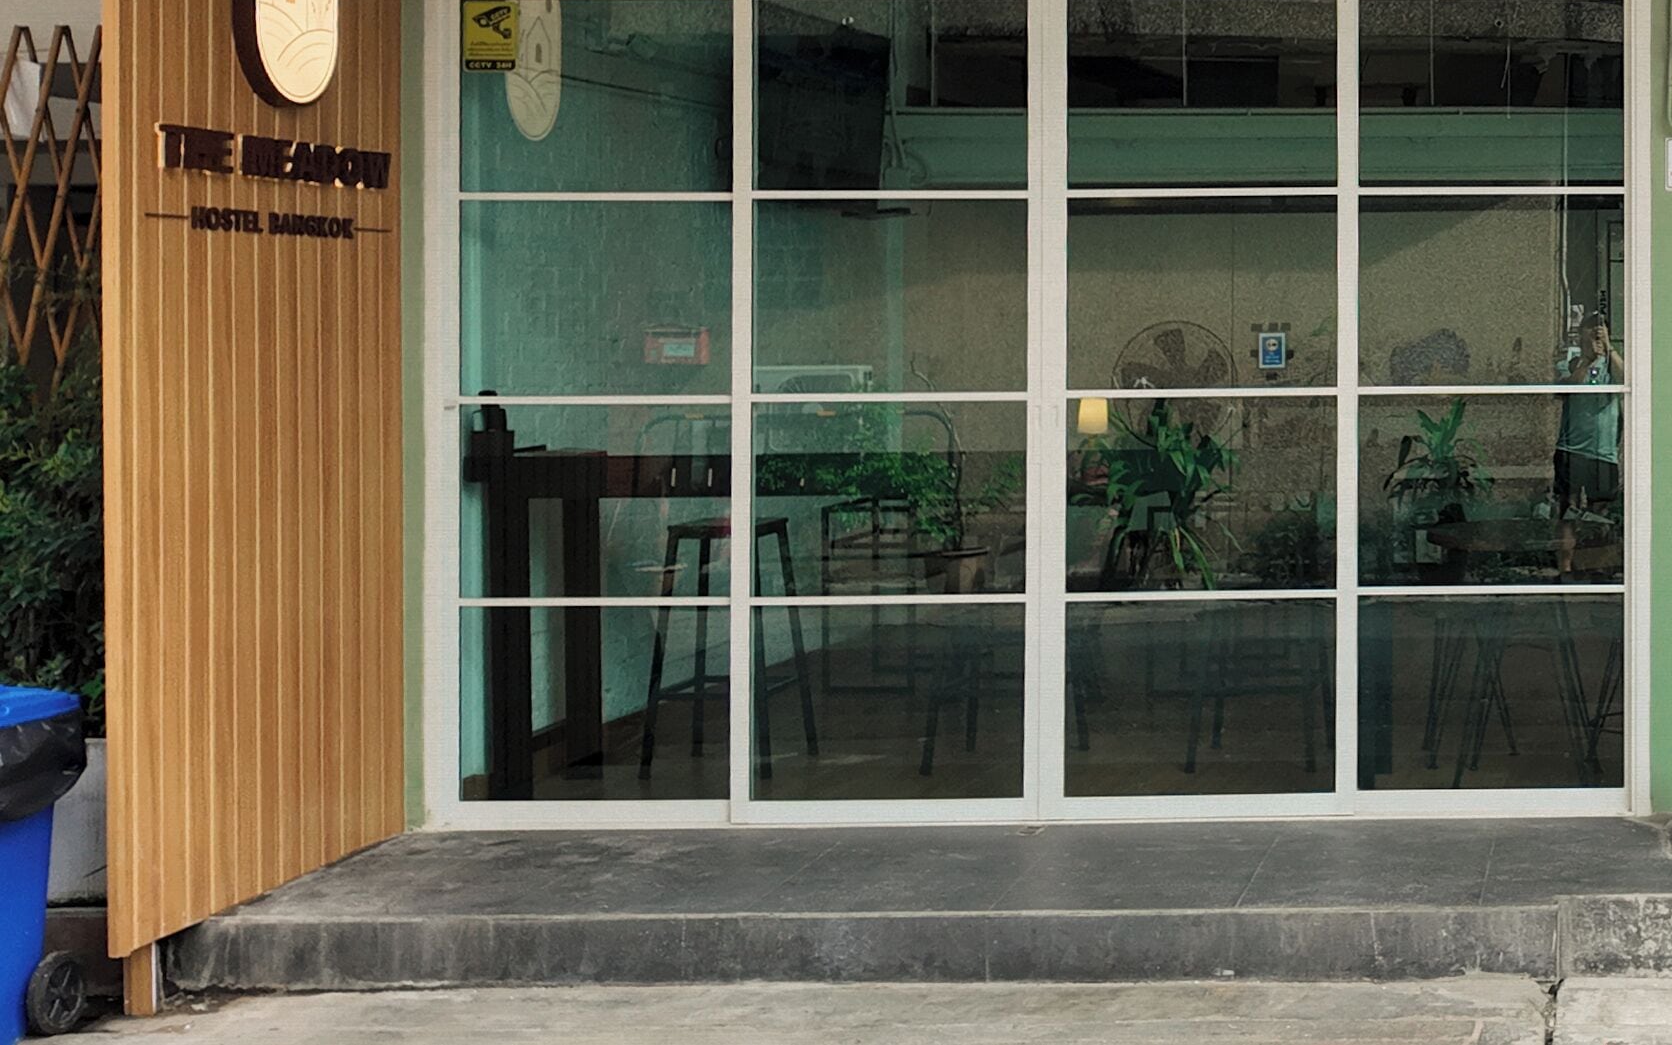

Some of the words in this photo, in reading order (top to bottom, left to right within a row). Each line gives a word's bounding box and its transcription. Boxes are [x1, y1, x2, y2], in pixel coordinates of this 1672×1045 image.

[154, 123, 234, 173] THE
[238, 134, 392, 189] MEADOW
[191, 206, 263, 234] HOSTEL
[268, 212, 355, 239] BANGKOK
